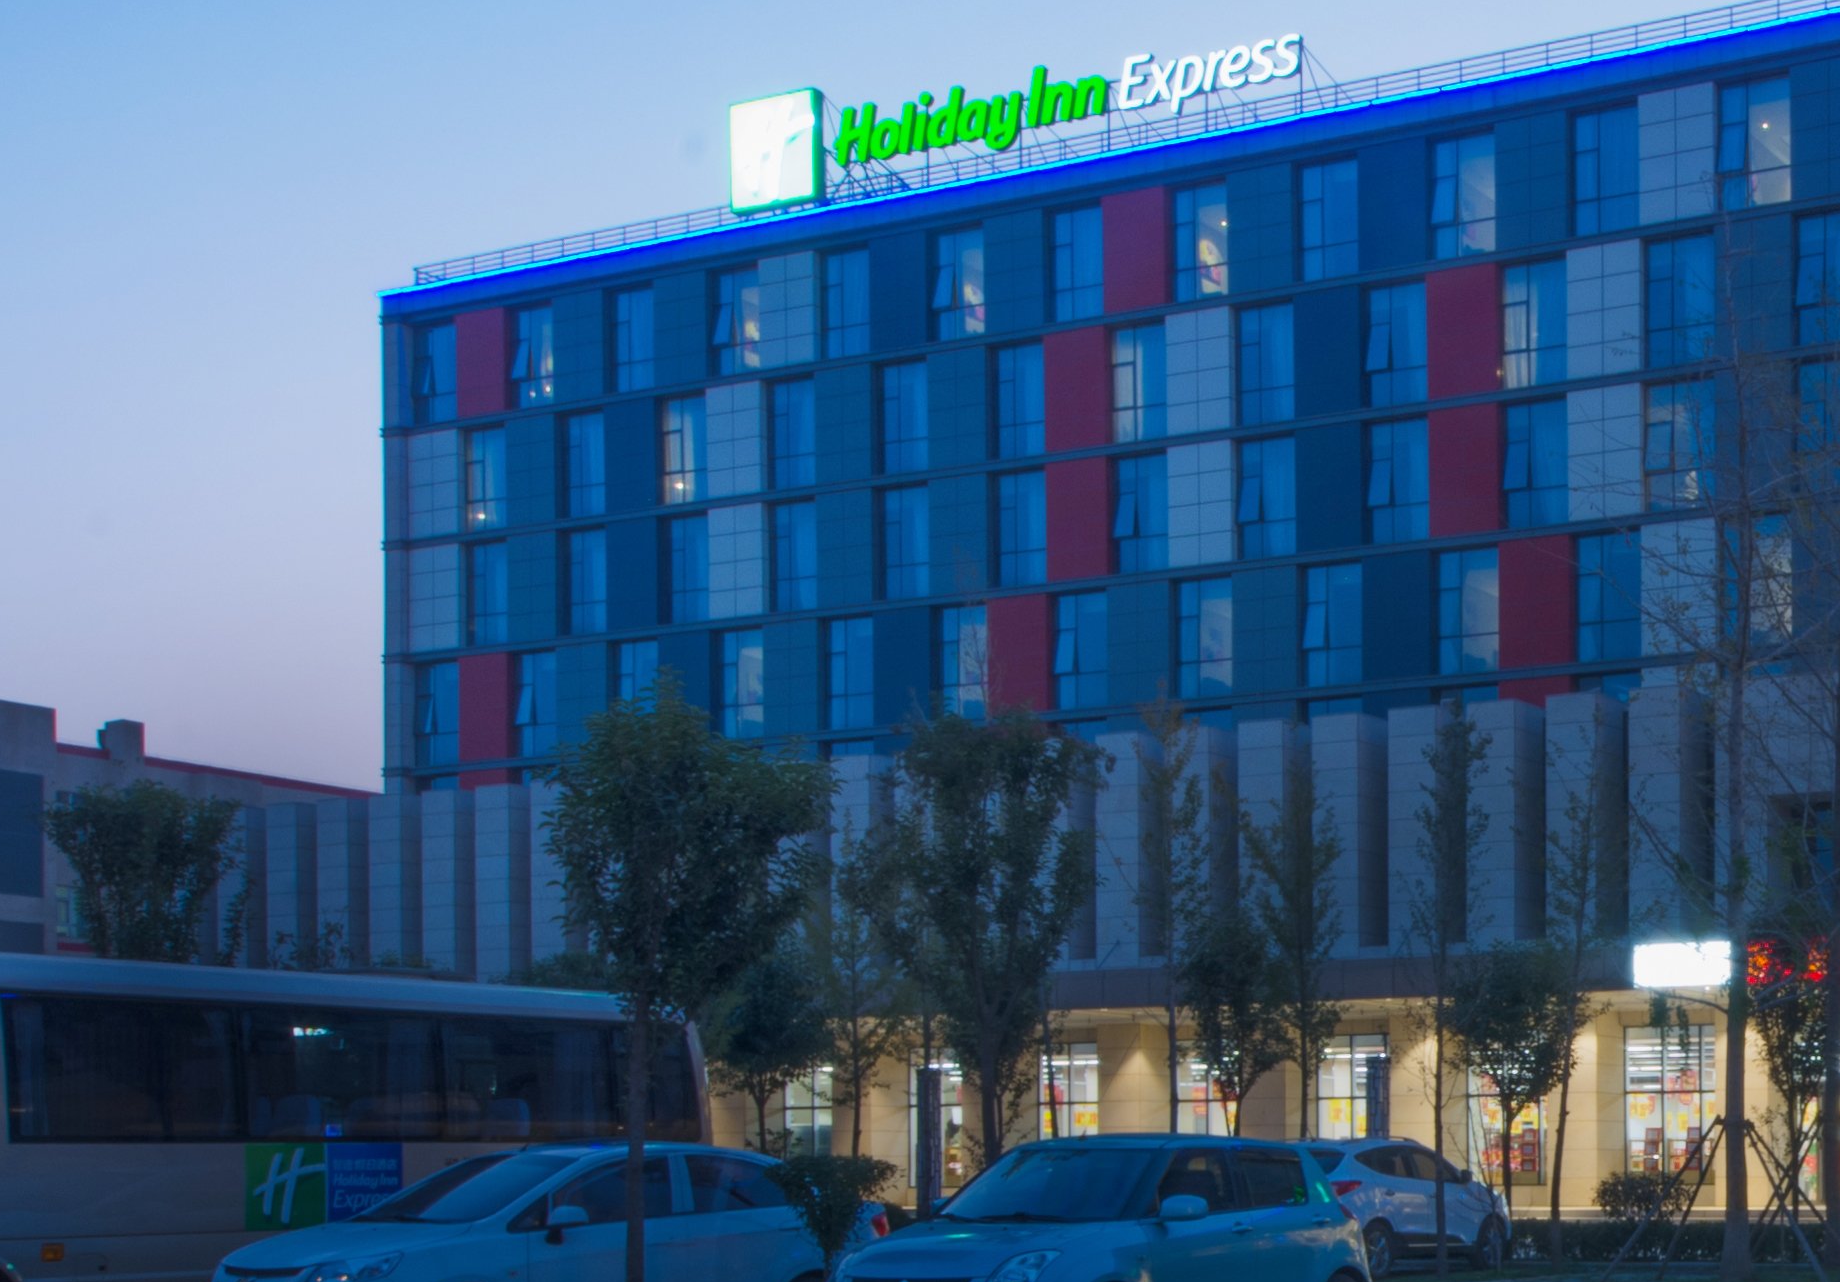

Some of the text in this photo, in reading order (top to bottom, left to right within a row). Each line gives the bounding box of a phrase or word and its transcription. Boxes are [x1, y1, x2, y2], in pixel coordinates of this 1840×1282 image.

[834, 34, 1301, 167] Holiday Inn Express
[334, 1172, 398, 1189] Holiday Inn
